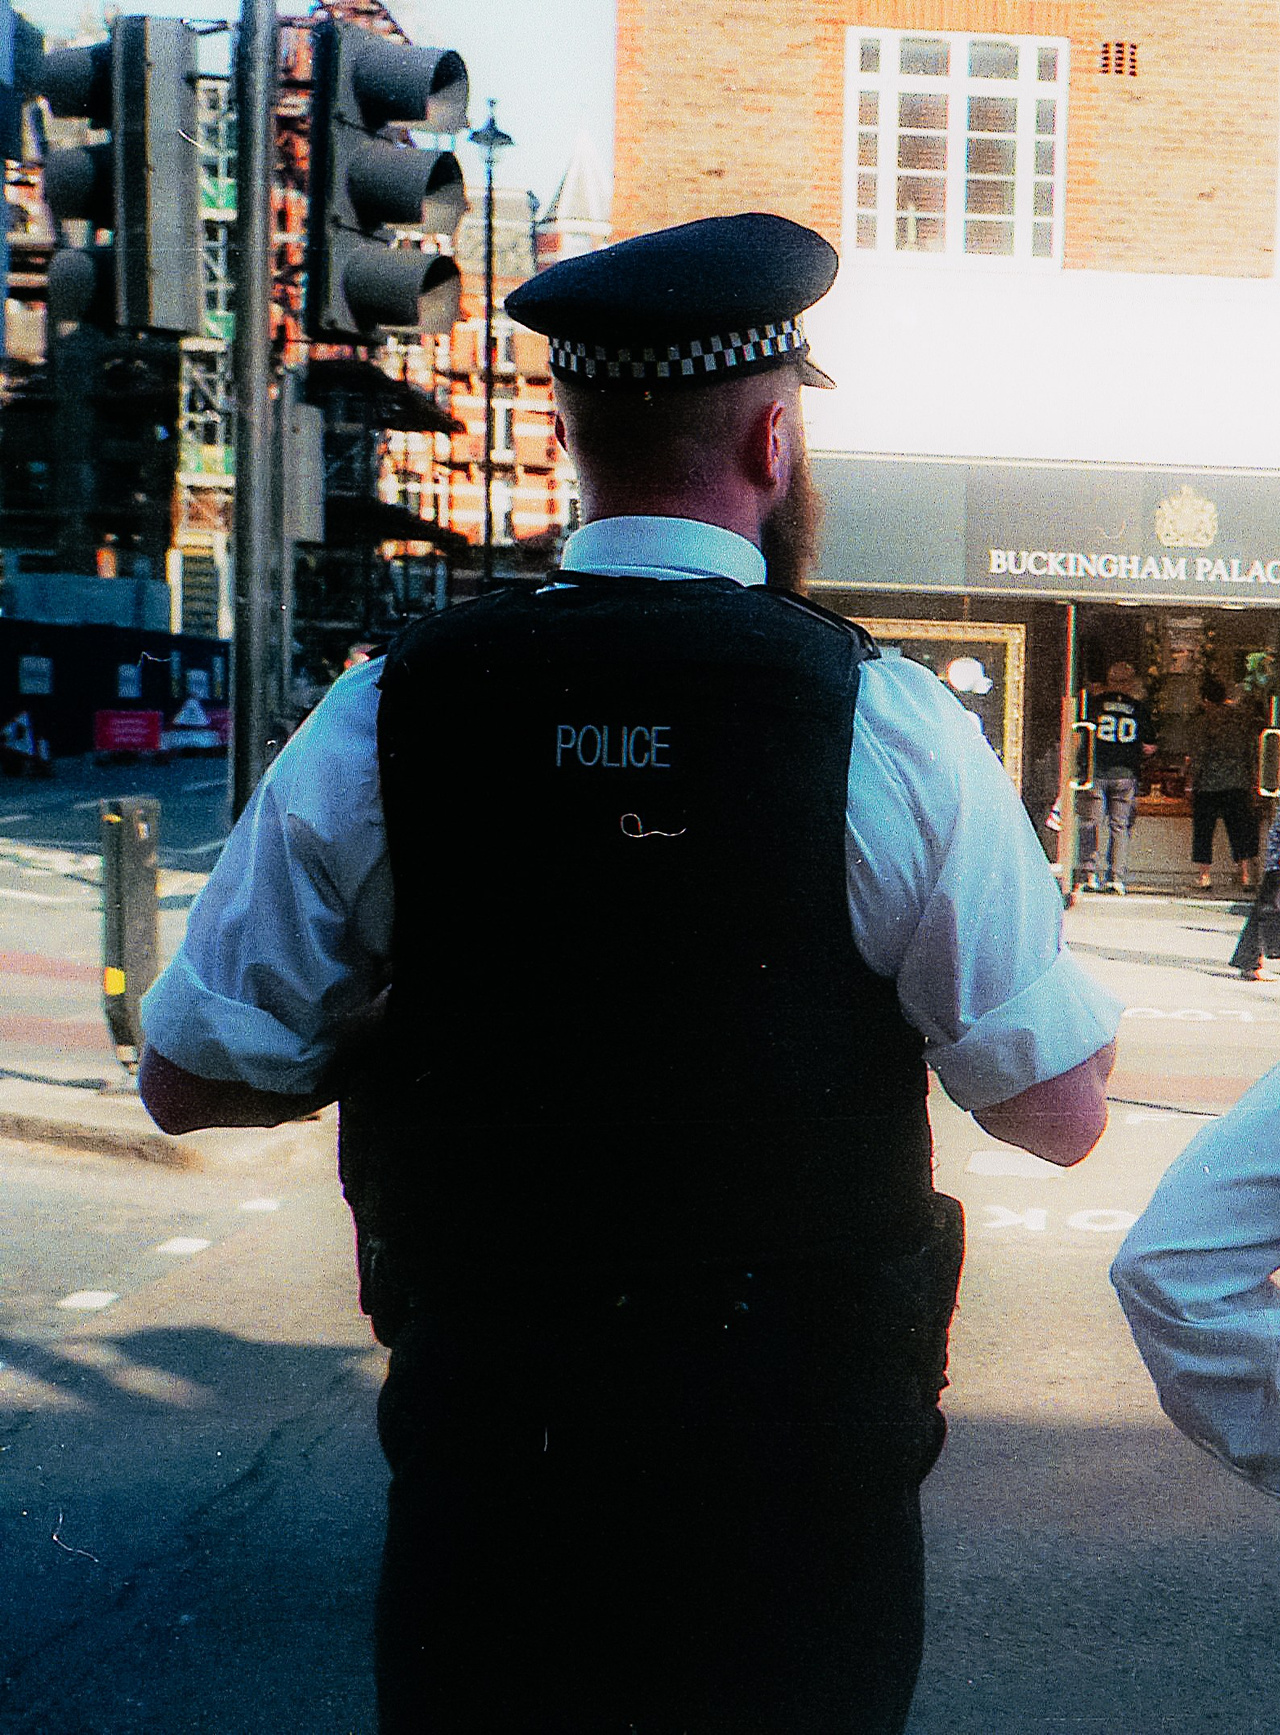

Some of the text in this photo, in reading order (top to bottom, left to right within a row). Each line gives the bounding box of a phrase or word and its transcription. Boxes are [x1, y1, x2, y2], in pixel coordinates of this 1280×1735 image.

[989, 548, 1187, 581] BUCKINGHAM
[1097, 714, 1137, 743] 20
[556, 724, 672, 768] POLICE
[1121, 1006, 1255, 1022] LOO
